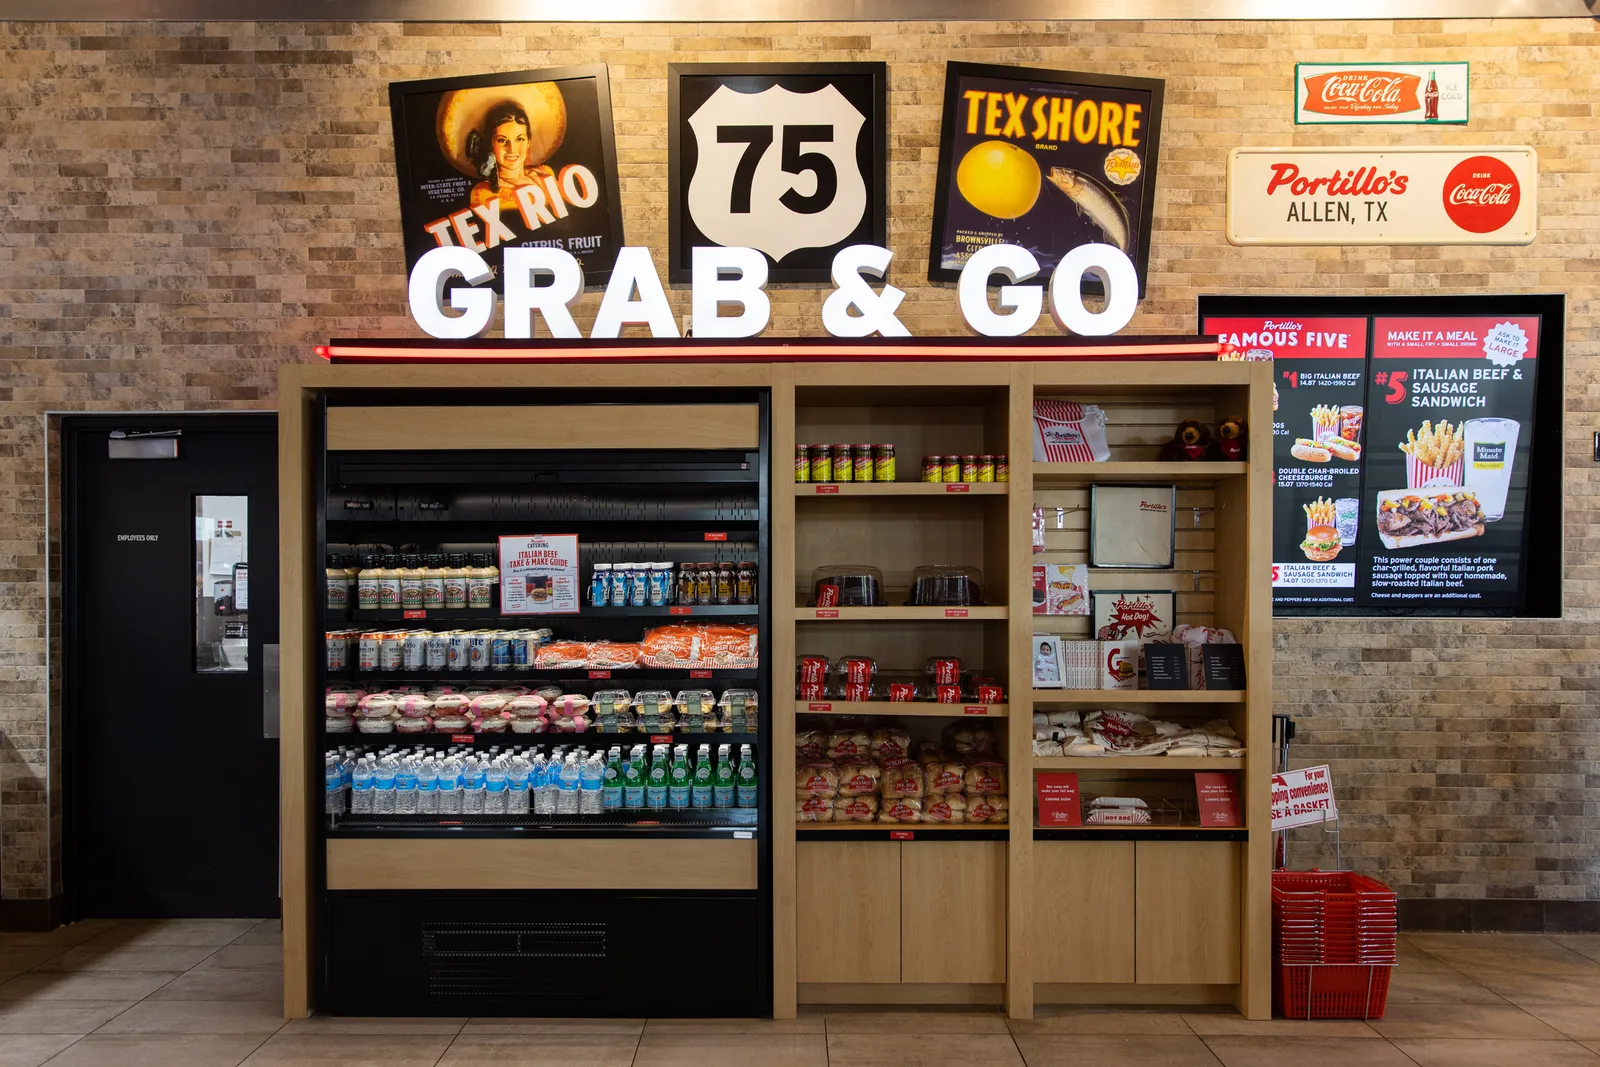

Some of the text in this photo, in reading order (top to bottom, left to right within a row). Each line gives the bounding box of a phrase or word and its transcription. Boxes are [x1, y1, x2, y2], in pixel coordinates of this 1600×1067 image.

[1441, 93, 1463, 101] COLD
[963, 89, 1142, 147] TEX SHORE
[1035, 143, 1058, 151] BRAND
[717, 124, 838, 215] 75
[420, 182, 452, 190] INTER-STATE
[452, 180, 467, 188] FRUIT
[1266, 163, 1409, 197] Portillo's
[428, 187, 456, 195] VEGETABLE
[1449, 182, 1514, 207] Coca-Cola
[424, 164, 599, 255] TEX RIO
[1286, 201, 1388, 225] ALLEN, TX
[568, 235, 602, 250] FRUIT
[408, 243, 1139, 339] GRAB & GO
[1263, 320, 1303, 331] Portillo's
[1218, 331, 1298, 347] FAMOUS
[1387, 331, 1478, 341] MAKE IT A MEAL
[1494, 336, 1511, 346] MAKE
[1497, 331, 1510, 339] ASK
[1488, 344, 1519, 358] LARGE
[1282, 370, 1298, 388] #1
[1413, 368, 1523, 380] ITALIAN BEEF &
[1374, 371, 1408, 405] #5
[1412, 382, 1478, 394] SAUSAGE
[1411, 396, 1486, 408] SANDWICH
[1139, 501, 1167, 510] Portillo's
[518, 550, 558, 559] ITALIAN BEEF
[1390, 557, 1413, 565] power
[1414, 556, 1440, 565] couple
[509, 559, 525, 568] TAKE
[531, 558, 549, 566] MAKE
[549, 559, 569, 567] GUIDE
[1372, 564, 1417, 572] char-grilled,
[1476, 564, 1494, 572] pork
[1272, 566, 1280, 583] 5
[1404, 572, 1430, 580] topped
[1464, 572, 1507, 580] homemade,
[1116, 600, 1155, 611] Portillo's
[1121, 612, 1150, 622] Hot Dog!
[1304, 770, 1325, 781] For your
[1289, 782, 1329, 800] convenience
[1272, 798, 1329, 820] SE A BASKET
